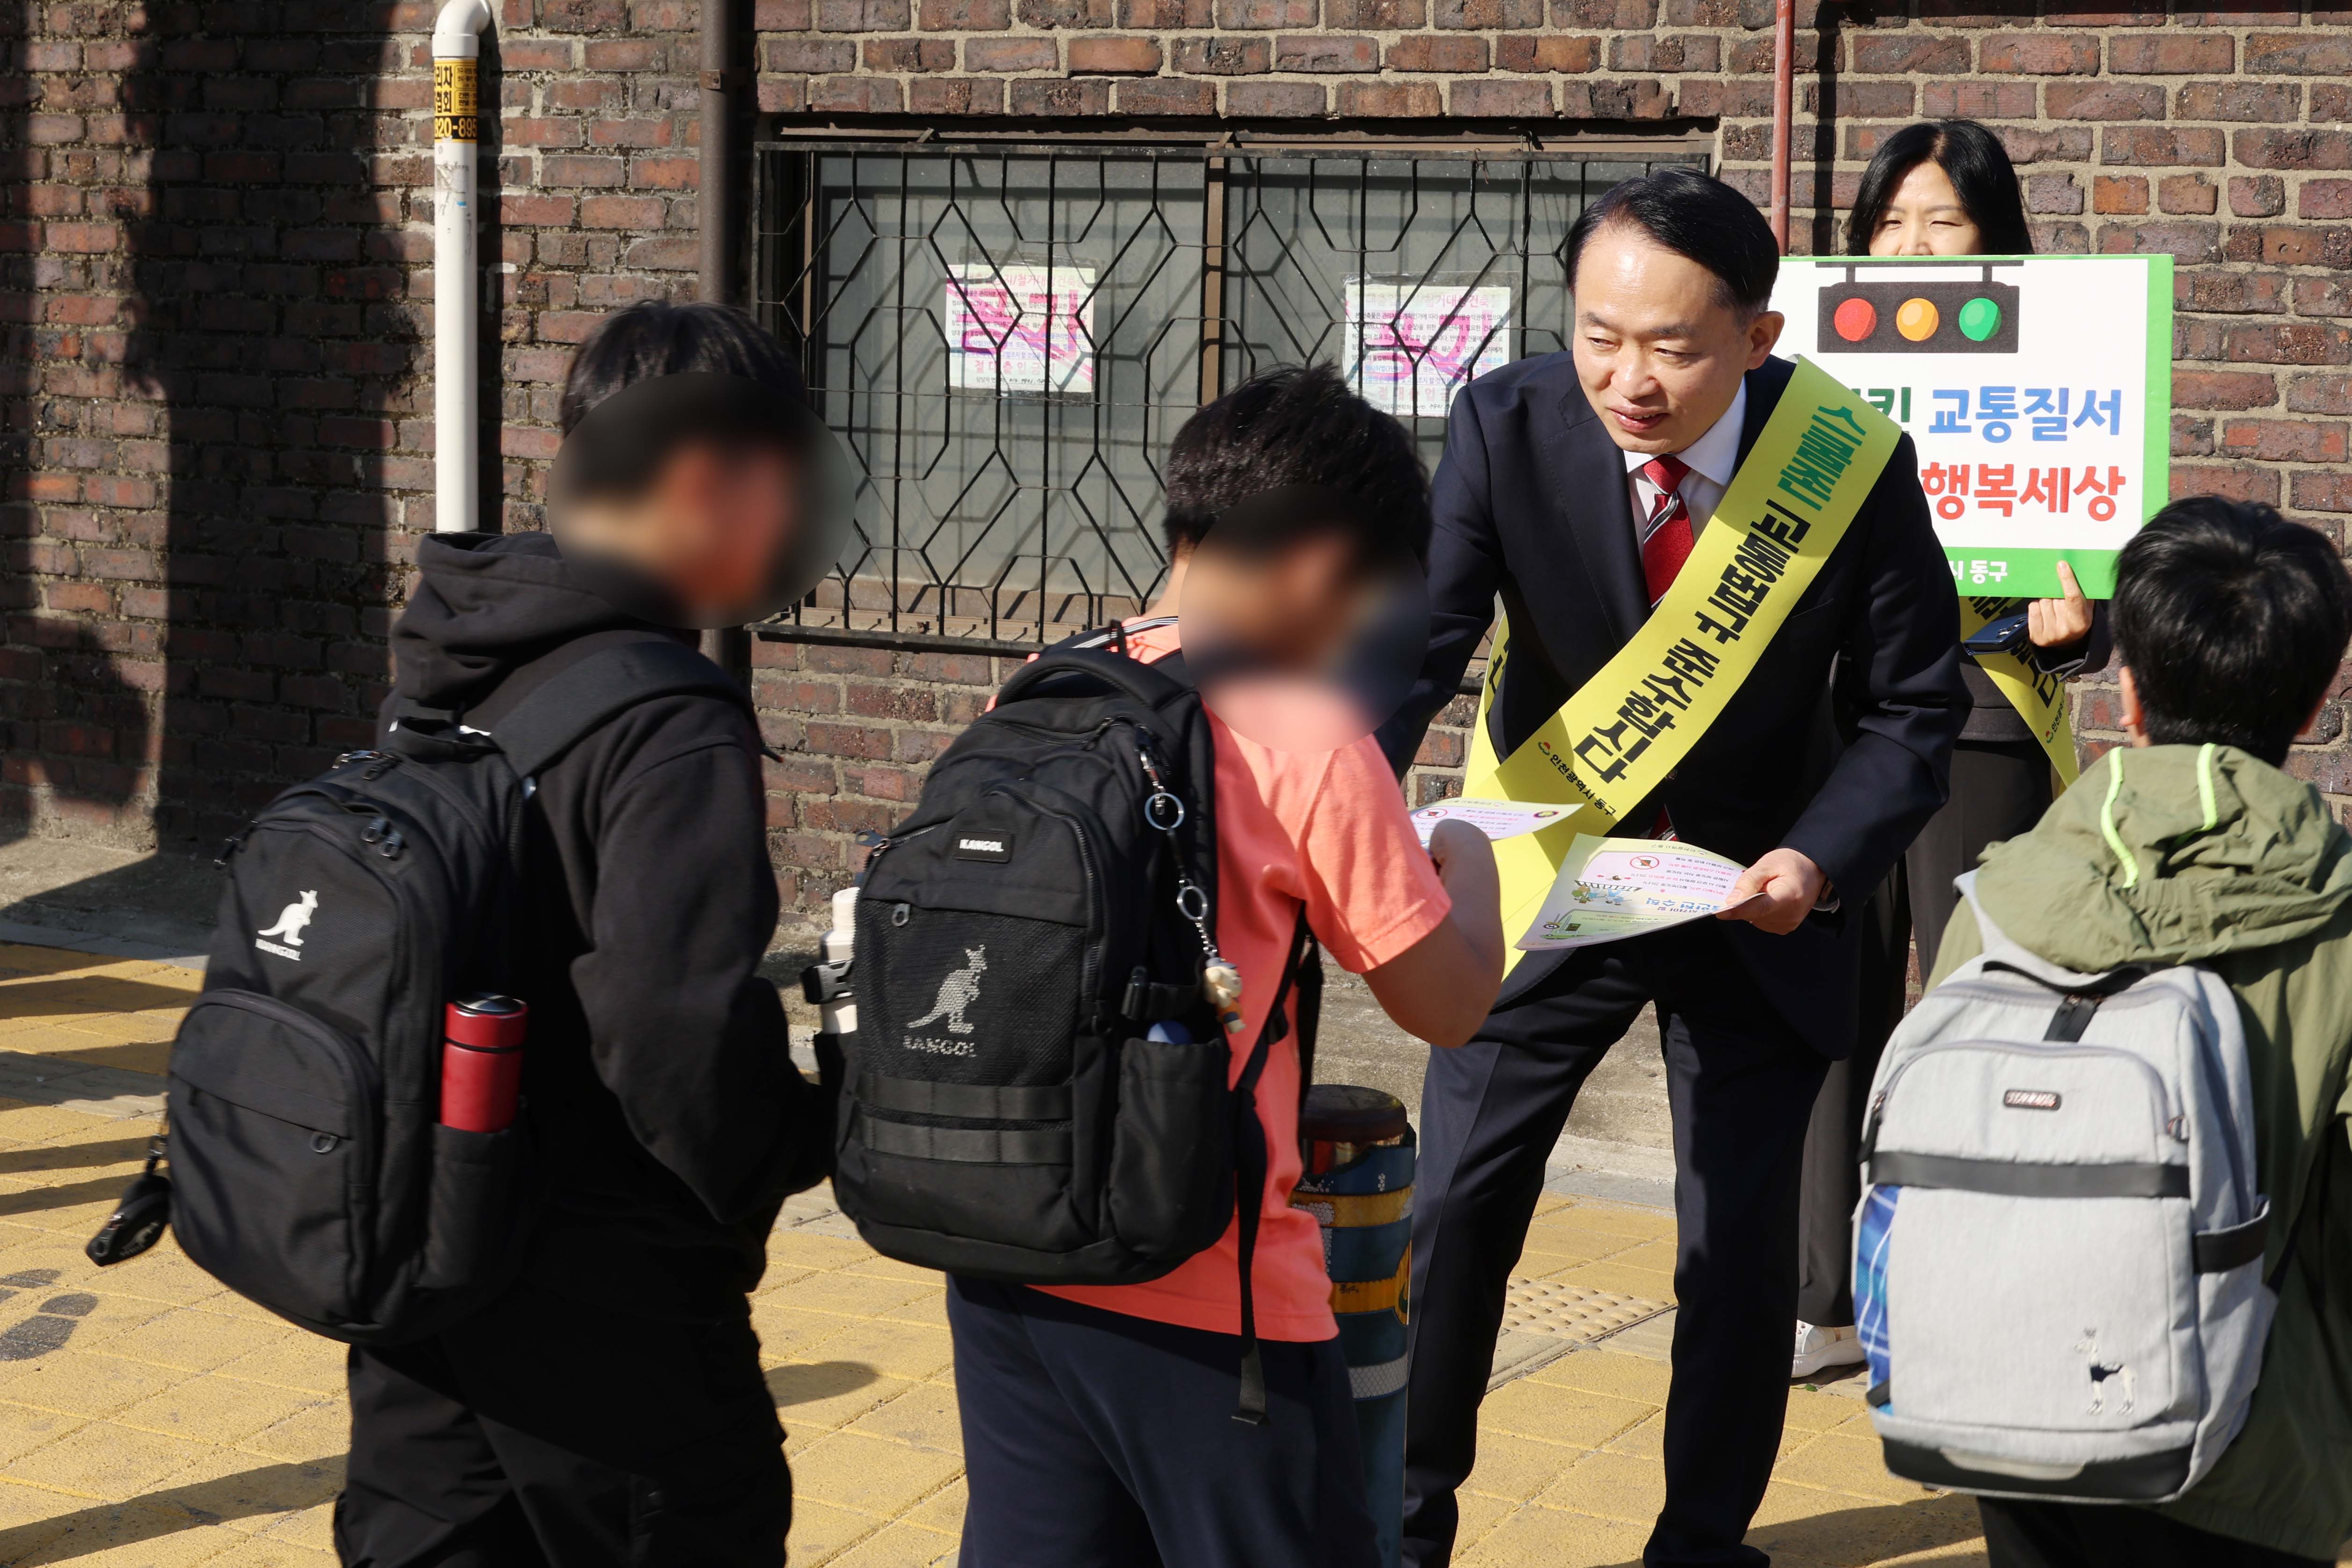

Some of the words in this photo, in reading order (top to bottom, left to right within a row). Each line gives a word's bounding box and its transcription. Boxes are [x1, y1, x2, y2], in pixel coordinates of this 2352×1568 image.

[435, 66, 453, 88] 리차
[435, 90, 452, 113] 협회
[1928, 386, 2122, 443] 교통질서
[1777, 405, 1867, 512] 스쿨존
[1920, 462, 2126, 522] 행복세상
[1694, 498, 1811, 645] 교통법규
[1969, 560, 2008, 585] 동구
[1573, 637, 1721, 784] 준수합시다
[1550, 754, 1595, 799] 인천광역시
[1594, 798, 1616, 816] 동구
